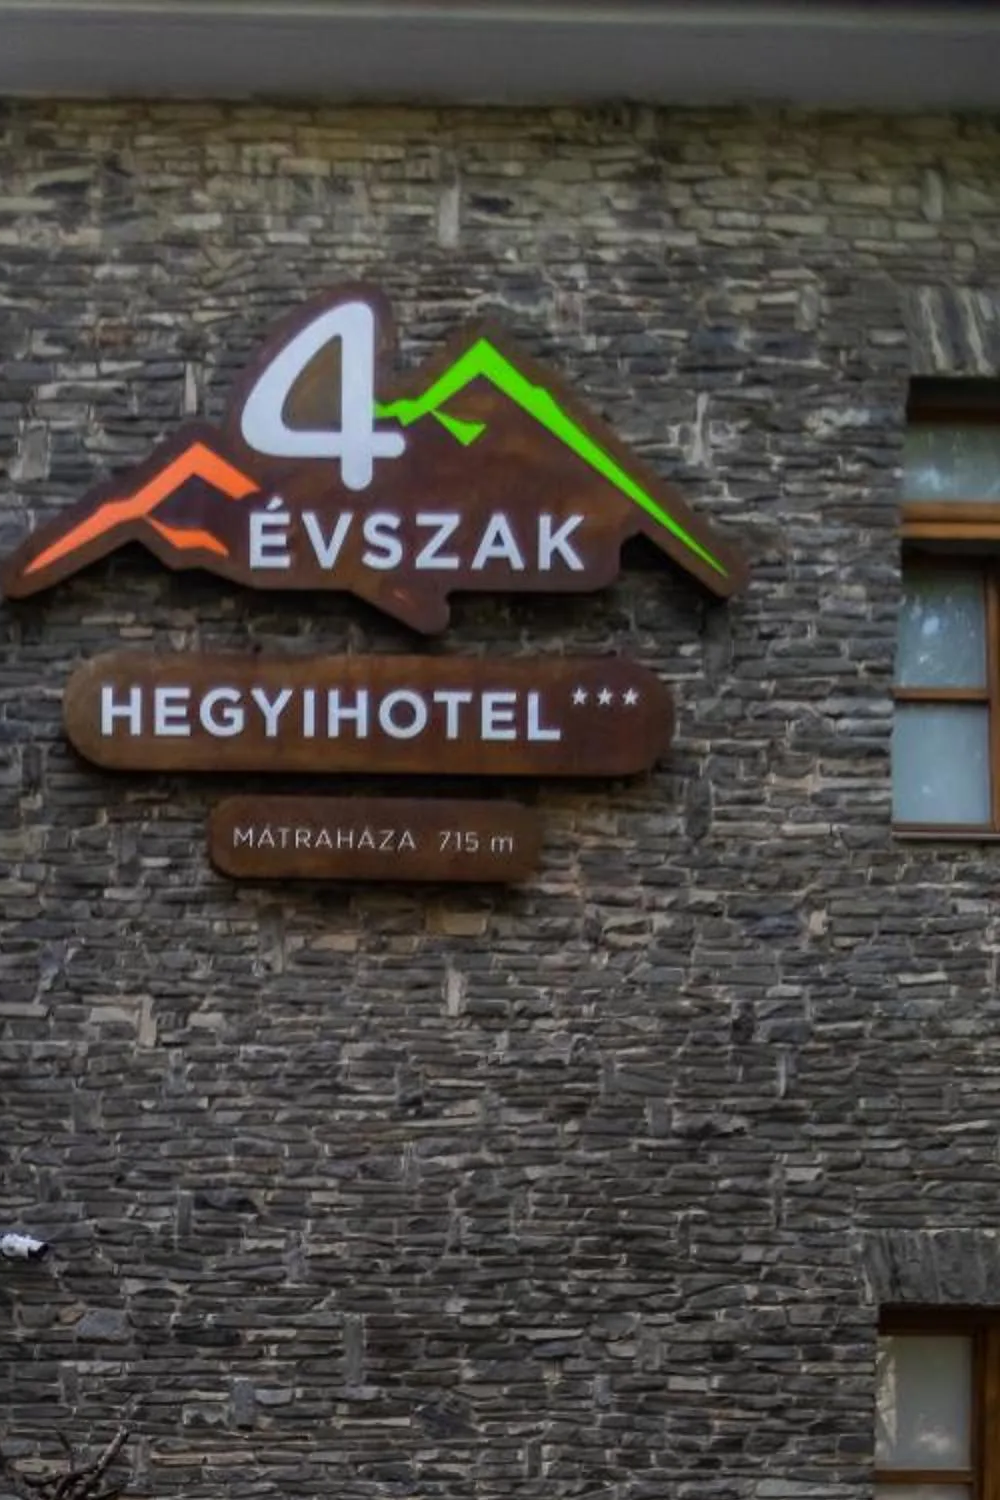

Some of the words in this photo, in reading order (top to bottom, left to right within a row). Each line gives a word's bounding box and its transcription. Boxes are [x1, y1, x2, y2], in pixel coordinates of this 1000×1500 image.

[240, 300, 406, 491] 4
[248, 496, 586, 572] ÉVSZAK
[101, 686, 562, 742] HEGYIHOTEL
[438, 830, 480, 853] 715
[490, 834, 514, 853] m
